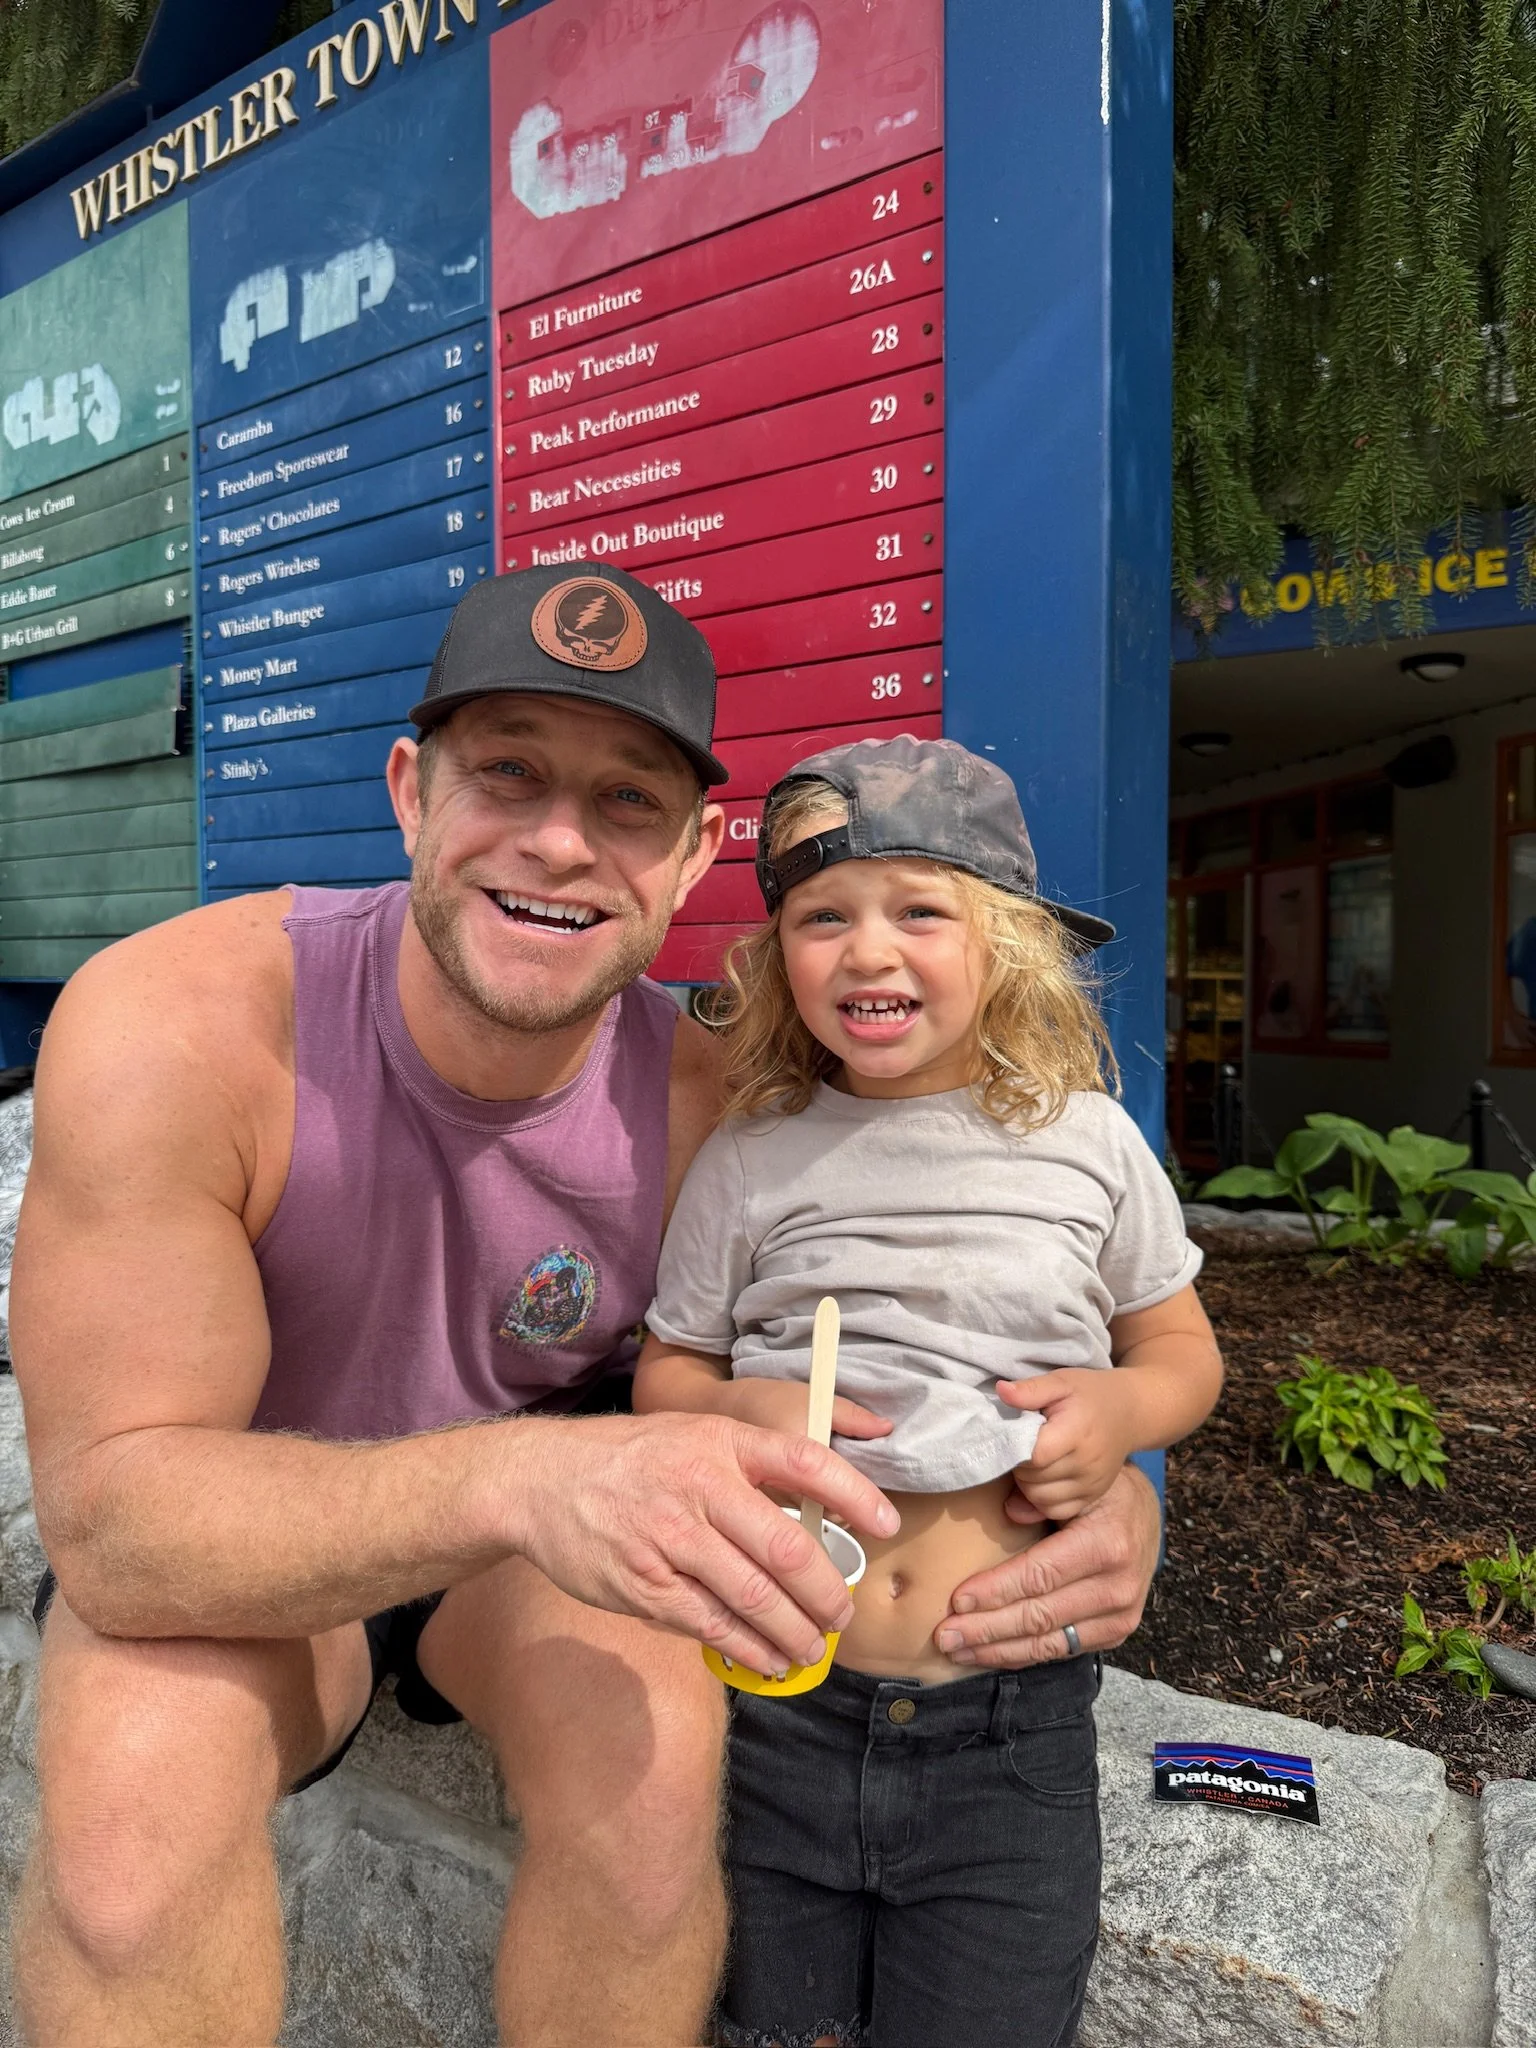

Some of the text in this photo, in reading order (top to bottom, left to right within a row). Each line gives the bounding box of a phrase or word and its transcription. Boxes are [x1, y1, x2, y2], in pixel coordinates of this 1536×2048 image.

[70, 0, 478, 241] WHISTLER TOWN
[871, 189, 900, 221] 24
[849, 259, 896, 296] 26A
[529, 285, 643, 341] El Furniture
[870, 324, 899, 355] 28
[444, 346, 463, 370] 12
[528, 338, 660, 399] Ruby Tuesday
[445, 402, 463, 425] 16
[529, 389, 701, 455] Peak Performance
[869, 394, 898, 426] 29
[217, 419, 273, 450] Caramba
[162, 453, 171, 472] 1
[218, 444, 350, 500] Freedom Sportswear
[446, 456, 463, 479] 17
[529, 457, 682, 515] Bear Necessities
[870, 465, 898, 494] 30
[0, 494, 76, 531] Cows Ice Cream
[164, 496, 174, 514] 4
[218, 498, 341, 547] Rogers' Chocolates
[446, 510, 464, 533] 18
[165, 541, 176, 561] 6
[530, 512, 725, 567] Inside Out Boutique
[875, 533, 903, 562] 31
[1, 545, 45, 569] Billabong
[219, 555, 321, 595] Rogers Wireless
[448, 566, 465, 588] 19
[1416, 550, 1509, 596] ICE
[0, 584, 57, 609] Eddie Bauer
[165, 587, 175, 607] 8
[652, 578, 703, 603] Gifts
[25, 622, 56, 643] Urban
[56, 615, 79, 635] Grill
[219, 604, 325, 639] Whistler Bungee
[869, 601, 898, 630] 32
[220, 656, 298, 688] Money Mart
[871, 671, 902, 701] 36
[222, 703, 316, 733] Plaza Galleries
[220, 757, 269, 781] Stinky's
[729, 817, 762, 841] Cli
[1168, 1771, 1306, 1803] patagonia
[1248, 1796, 1289, 1809] CANADA
